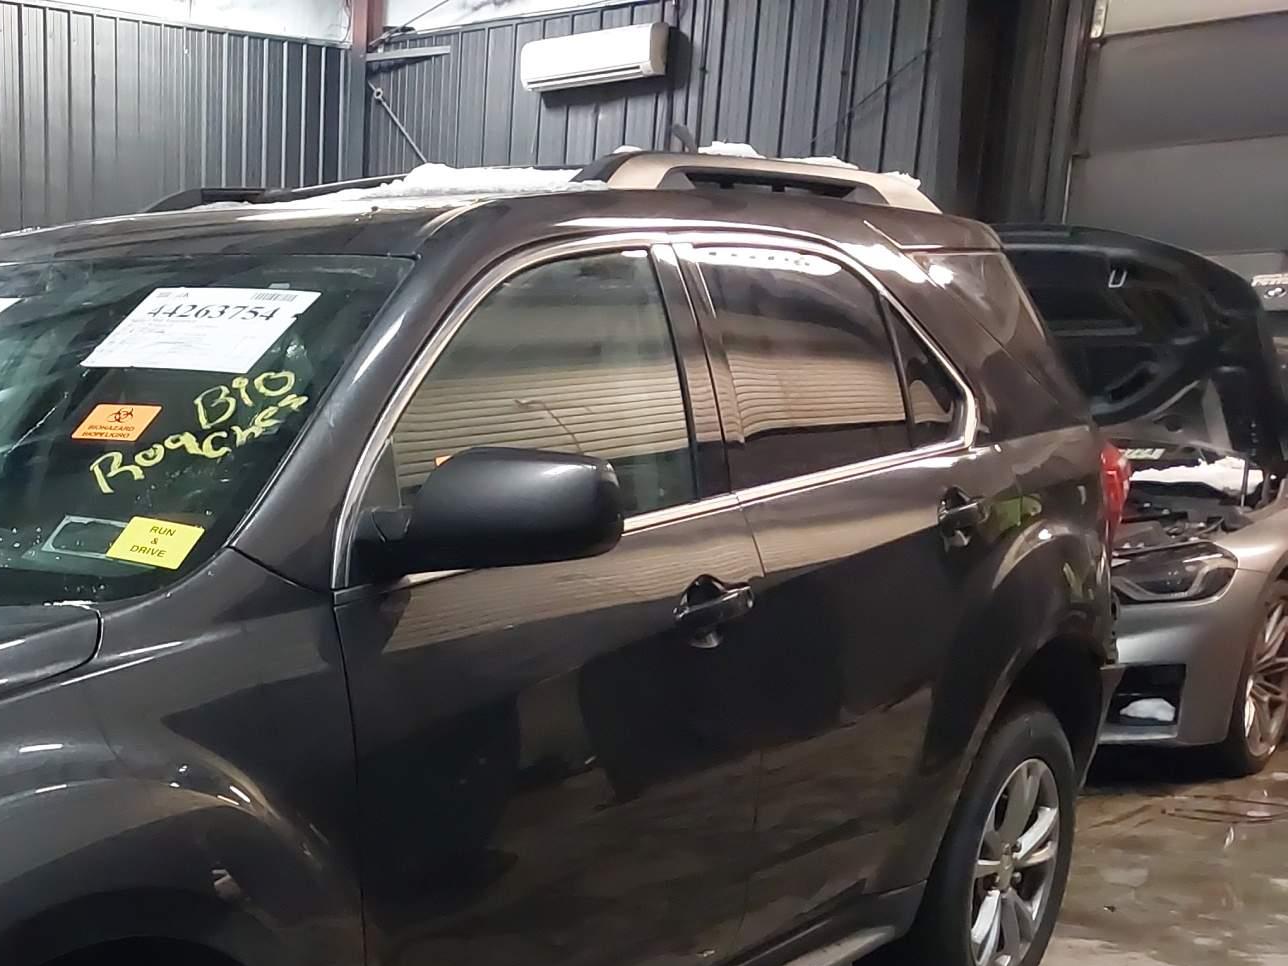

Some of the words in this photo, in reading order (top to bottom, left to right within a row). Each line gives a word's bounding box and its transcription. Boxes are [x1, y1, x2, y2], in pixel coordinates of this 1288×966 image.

[146, 303, 282, 321] 44263754
[87, 424, 136, 432] BIOHAZARD
[81, 431, 131, 439] BIOPELIGRO
[149, 525, 177, 537] RUN
[150, 537, 159, 545] &
[129, 544, 168, 558] DRIVE
